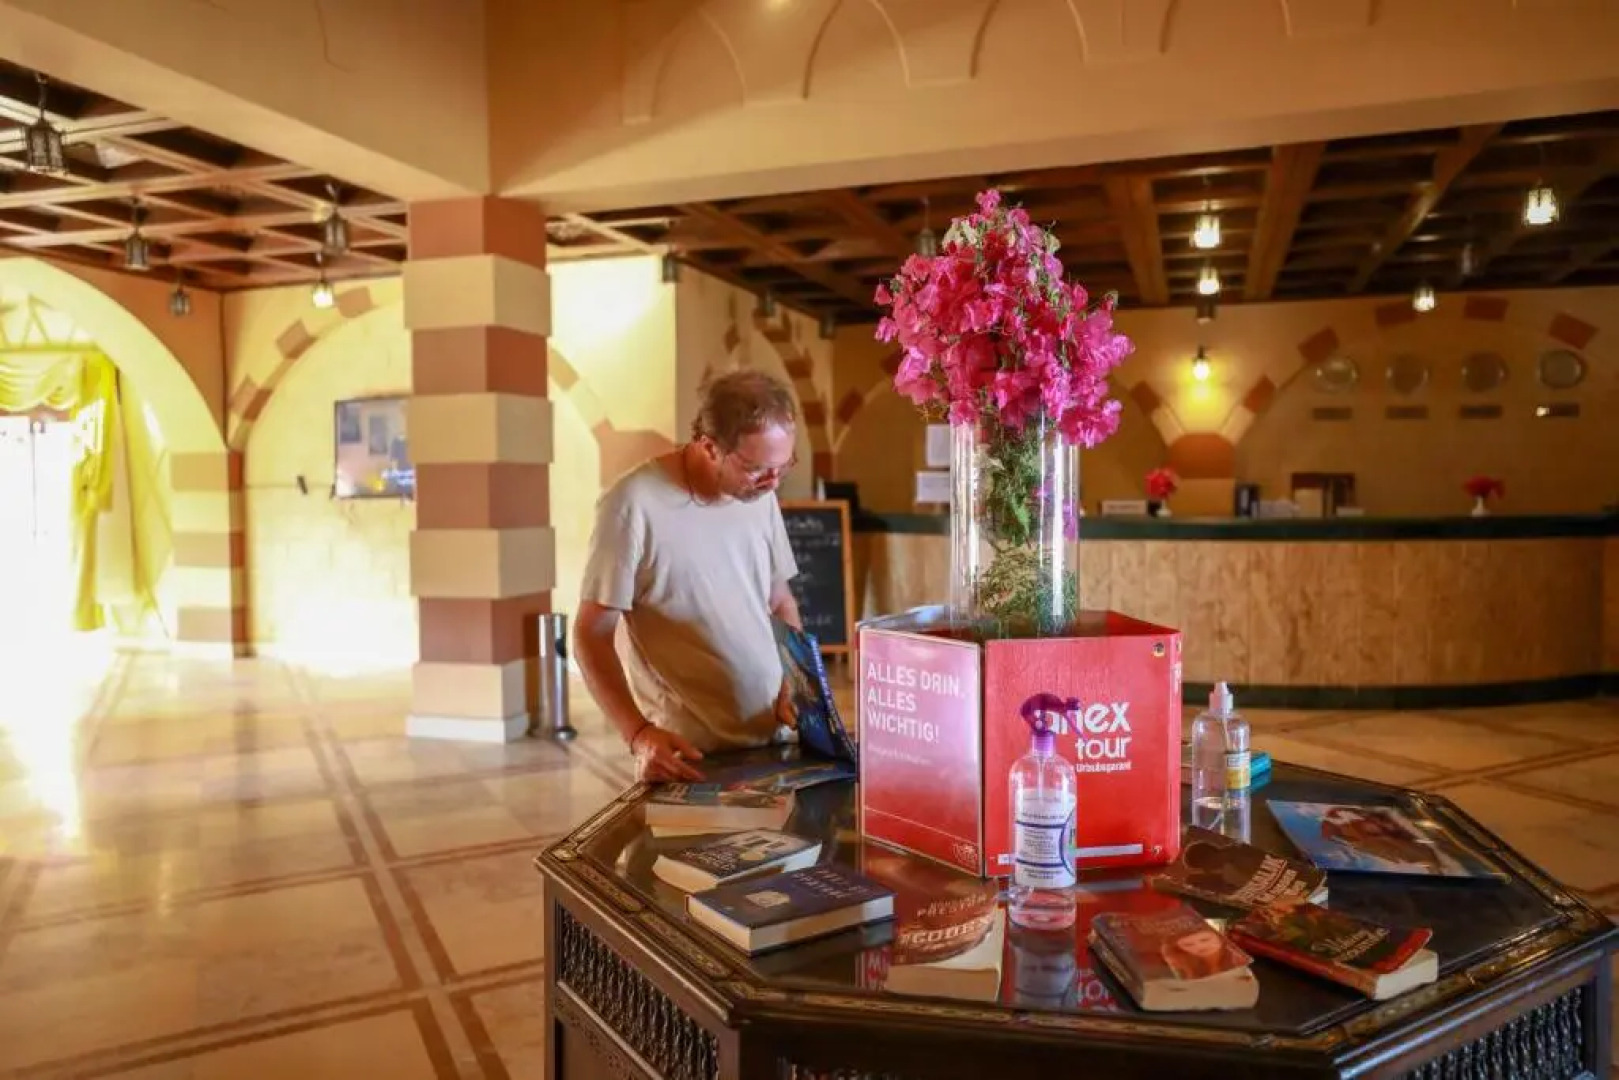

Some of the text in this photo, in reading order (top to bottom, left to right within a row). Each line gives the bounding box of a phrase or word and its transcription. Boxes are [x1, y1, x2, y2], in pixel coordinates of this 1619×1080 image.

[867, 662, 917, 688] ALLES
[867, 686, 917, 712] ALLES
[867, 708, 939, 744] WICHTIG!
[1075, 737, 1132, 760] tour
